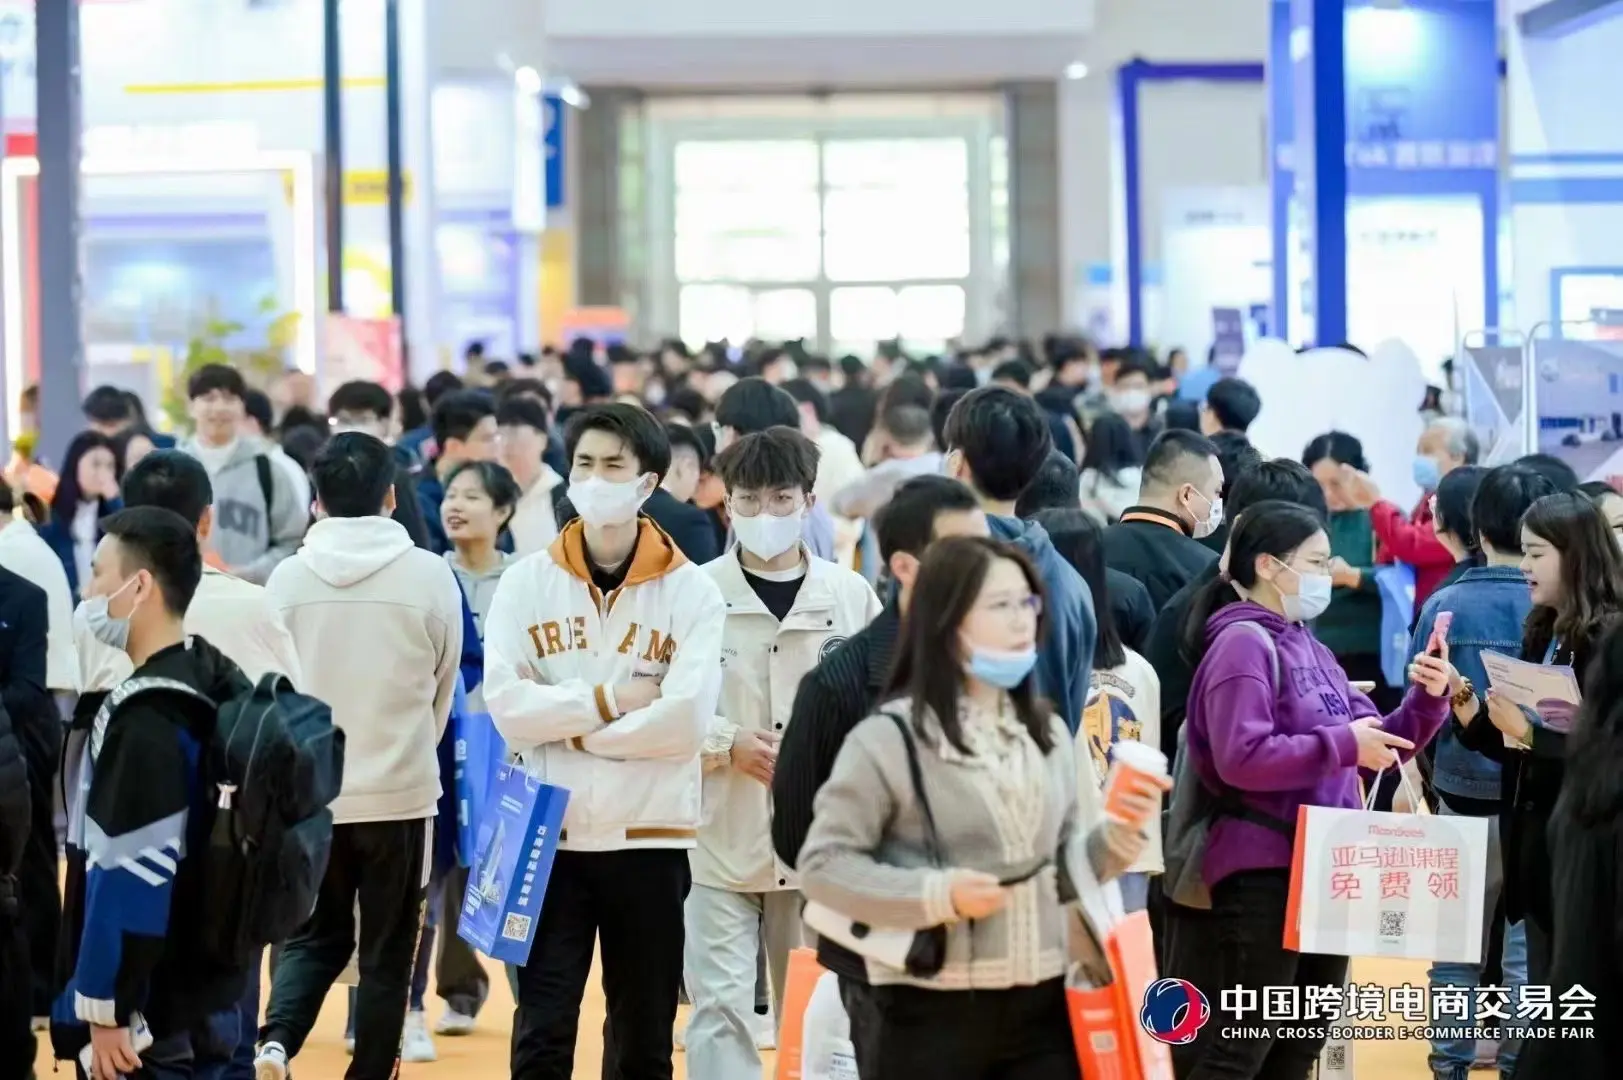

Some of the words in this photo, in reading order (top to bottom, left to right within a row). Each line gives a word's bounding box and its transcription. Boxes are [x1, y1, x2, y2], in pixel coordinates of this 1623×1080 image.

[1331, 846, 1459, 869] 亚马逊课程
